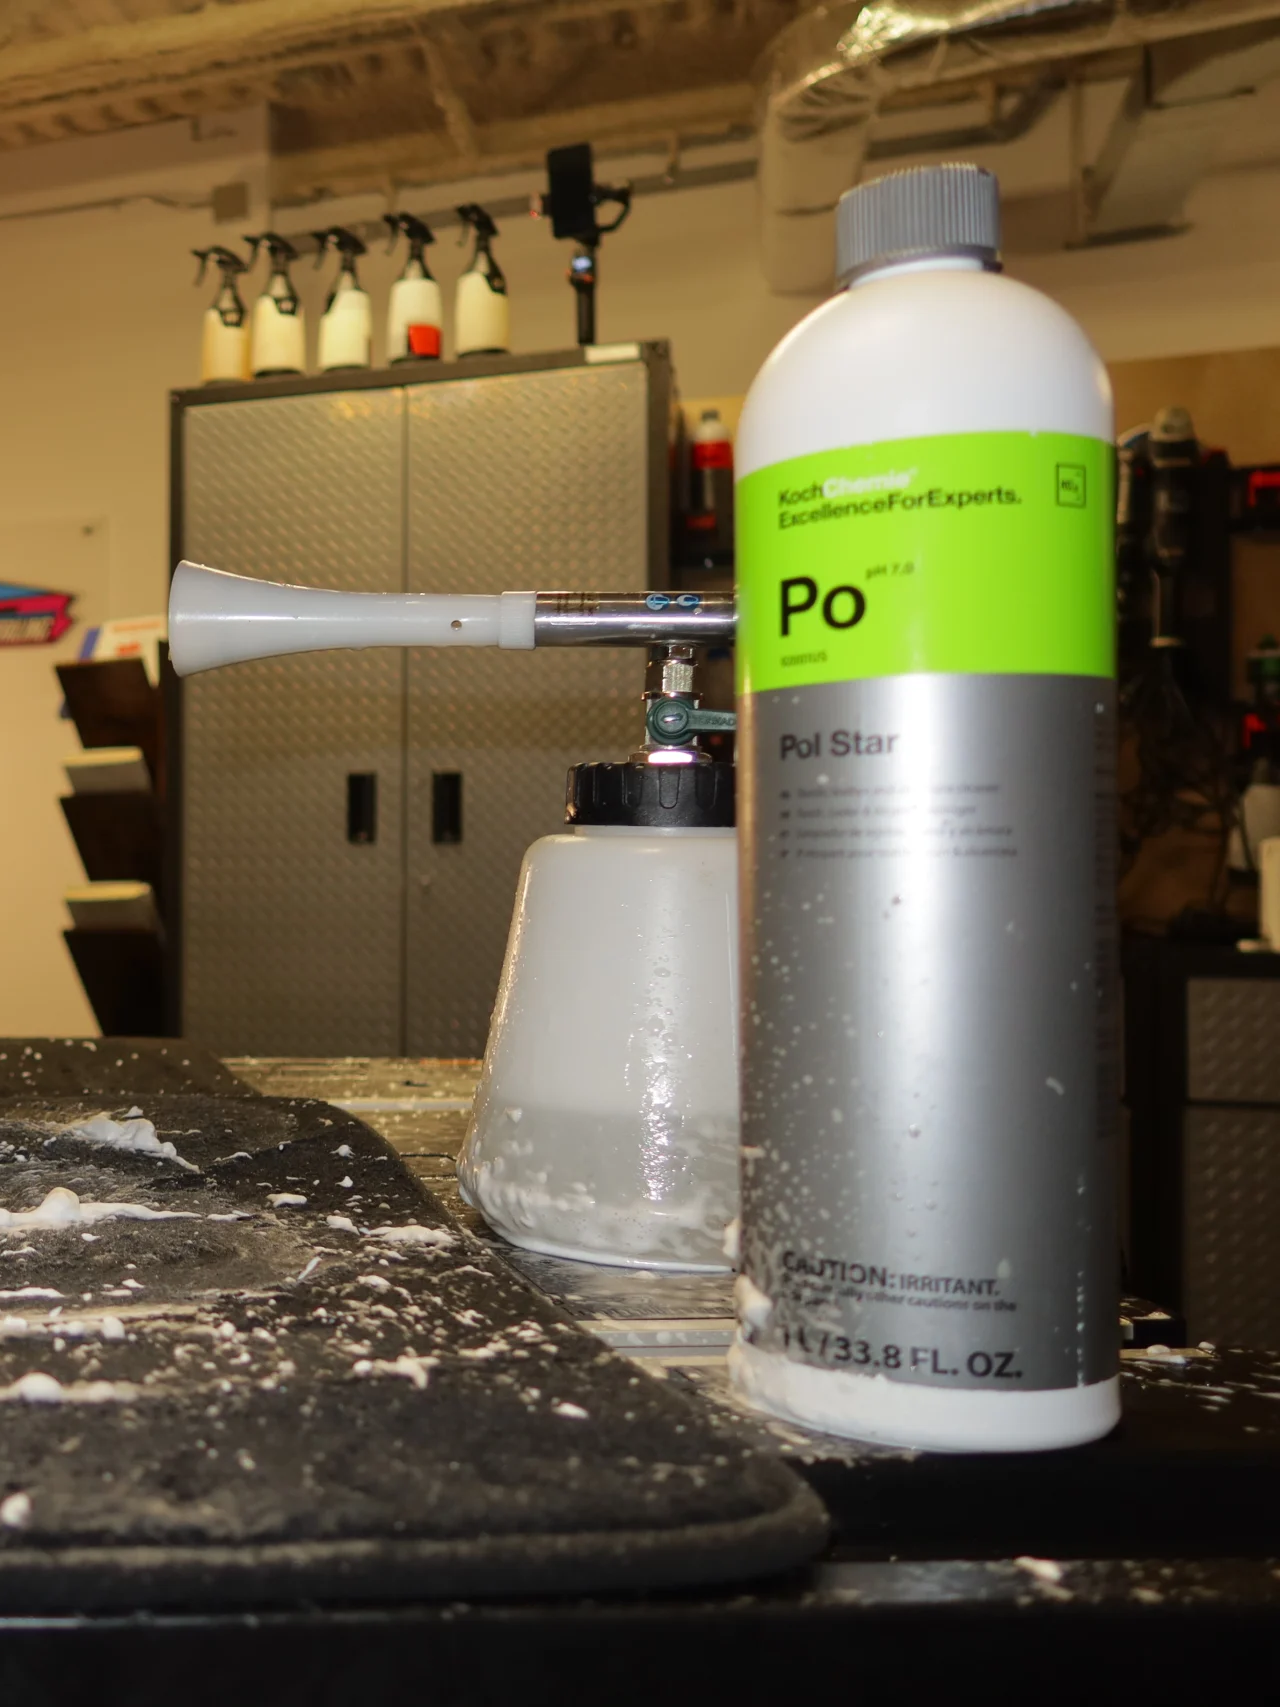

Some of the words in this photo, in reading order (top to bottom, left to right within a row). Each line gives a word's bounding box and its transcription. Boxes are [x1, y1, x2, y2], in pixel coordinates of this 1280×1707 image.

[778, 486, 1023, 530] ExcellenceForExperts.
[780, 575, 866, 638] Po
[780, 732, 821, 760] Pol
[830, 729, 900, 758] Star
[781, 1251, 896, 1289] CAUTION:
[900, 1274, 1001, 1297] IRRITANT.
